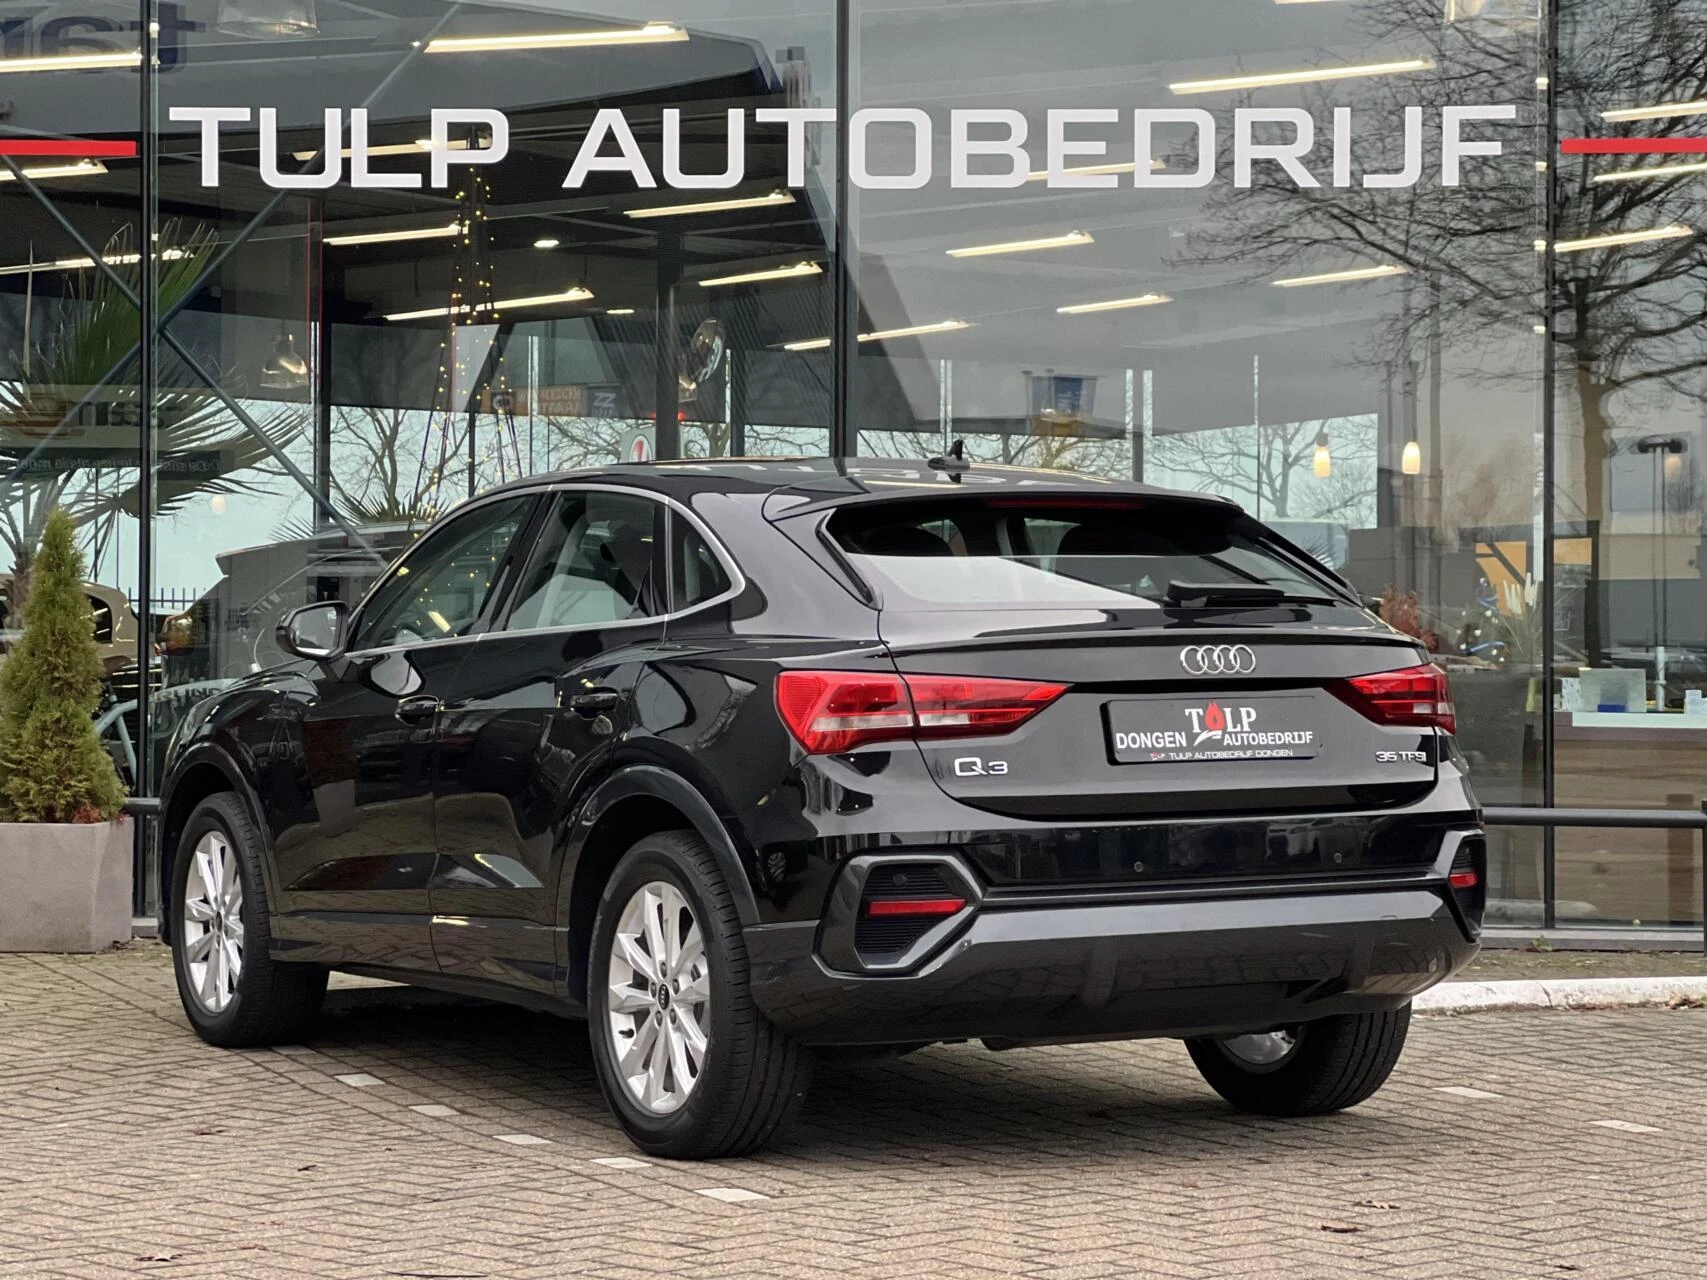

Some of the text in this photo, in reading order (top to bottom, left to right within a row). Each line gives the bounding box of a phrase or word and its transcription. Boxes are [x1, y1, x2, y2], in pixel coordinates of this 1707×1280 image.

[168, 104, 1517, 190] TULP AUTOBEDRIJF
[1116, 731, 1313, 749] DONGEN AUTOBEDRIJF
[1169, 752, 1192, 761] TULP
[1194, 749, 1253, 760] AUTOBEDRIJF
[1255, 749, 1293, 758] DONGEN
[1375, 751, 1427, 762] 35 TFSI
[954, 757, 1008, 777] Q3
